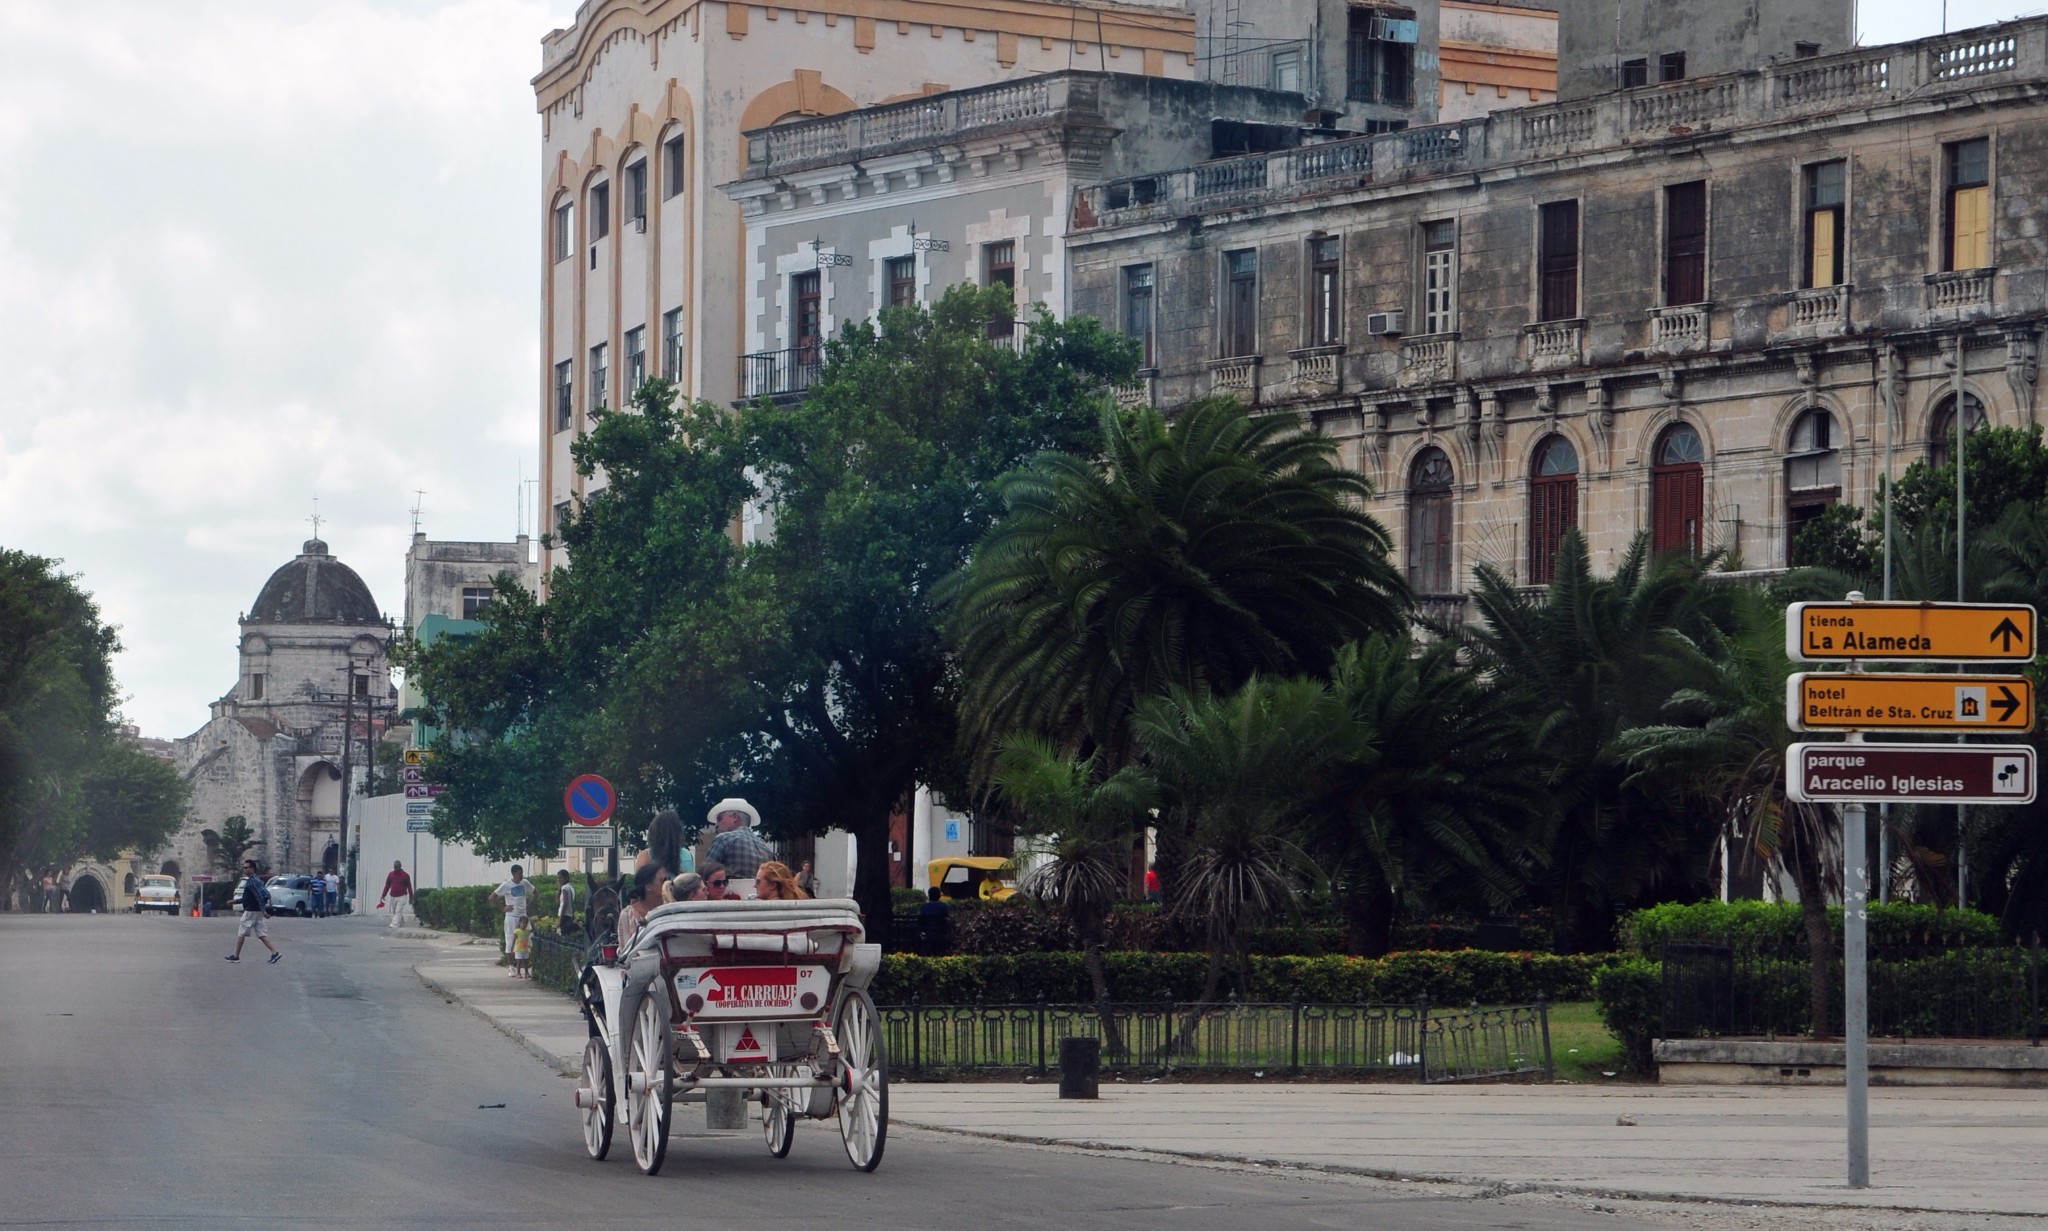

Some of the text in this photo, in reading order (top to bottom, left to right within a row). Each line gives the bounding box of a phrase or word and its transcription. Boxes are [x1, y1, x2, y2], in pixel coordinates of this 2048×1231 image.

[1809, 615, 1854, 627] tienda
[1809, 631, 1931, 650] La Alameda
[1808, 687, 1845, 700] hotel
[1809, 705, 1953, 719] Beltrán de Sta. Cruz
[1808, 756, 1866, 770] parque
[1808, 775, 1964, 794] Aracelio Iglesias
[800, 970, 813, 978] 07
[724, 984, 797, 1001] EL CARRUAJE
[715, 999, 792, 1008] COOPERATIVA DE COCHEROS
